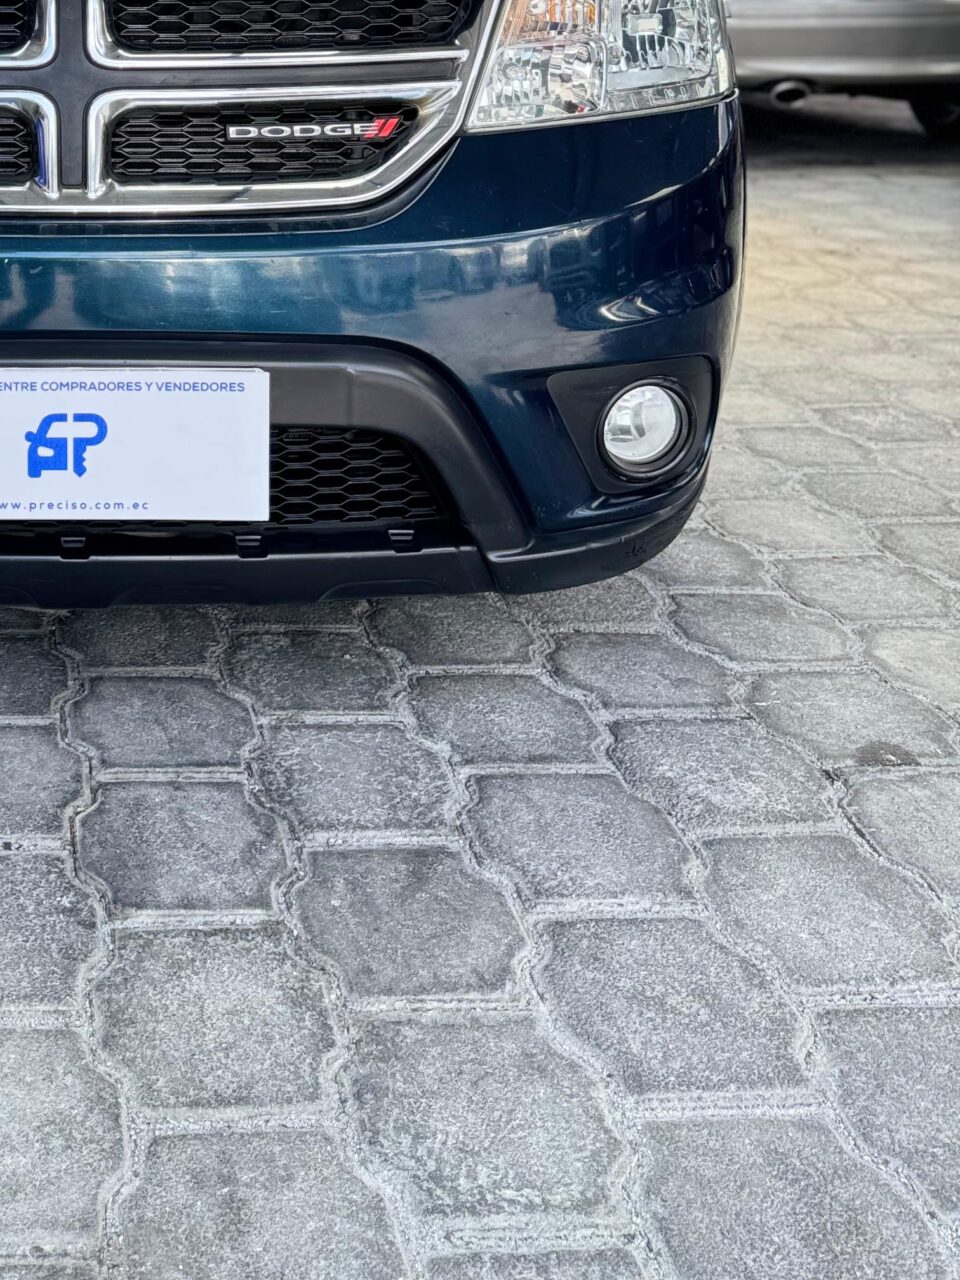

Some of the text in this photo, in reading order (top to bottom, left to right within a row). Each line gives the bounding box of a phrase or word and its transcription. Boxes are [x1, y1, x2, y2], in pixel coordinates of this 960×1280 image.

[228, 123, 379, 138] DODGE
[40, 381, 142, 392] COMPRADORES
[145, 381, 154, 392] Y
[155, 381, 245, 392] VENDEDORES
